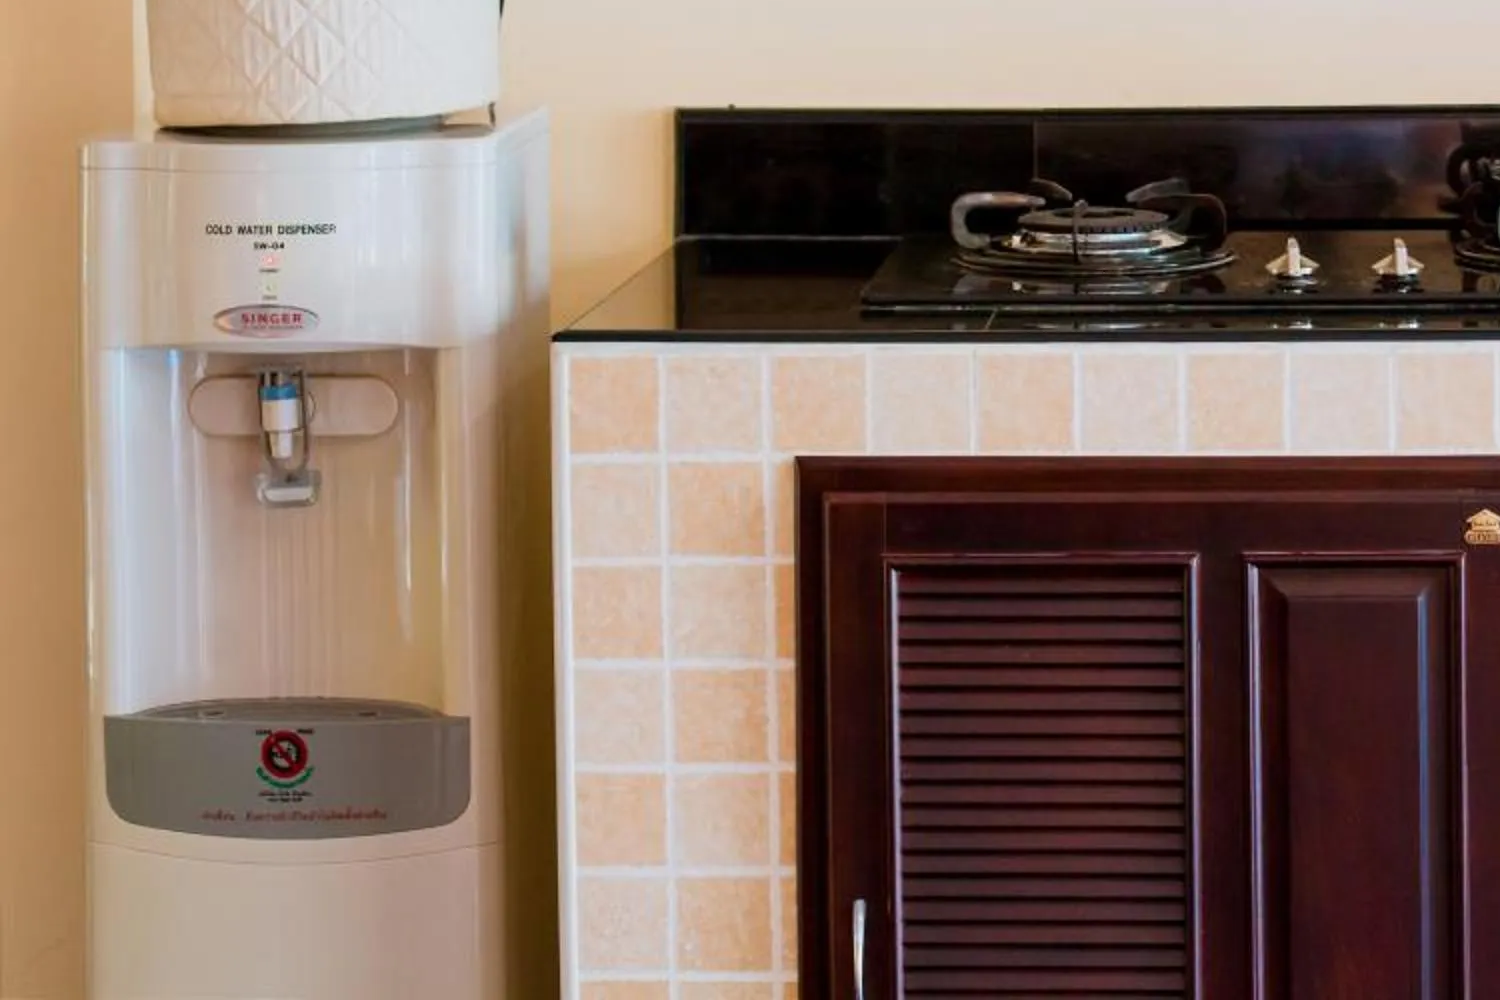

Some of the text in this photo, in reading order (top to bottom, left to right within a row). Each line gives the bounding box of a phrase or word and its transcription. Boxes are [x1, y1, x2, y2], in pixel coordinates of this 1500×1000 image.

[205, 223, 337, 235] COLD WATER DISPENSER
[241, 313, 303, 325] SINGER
